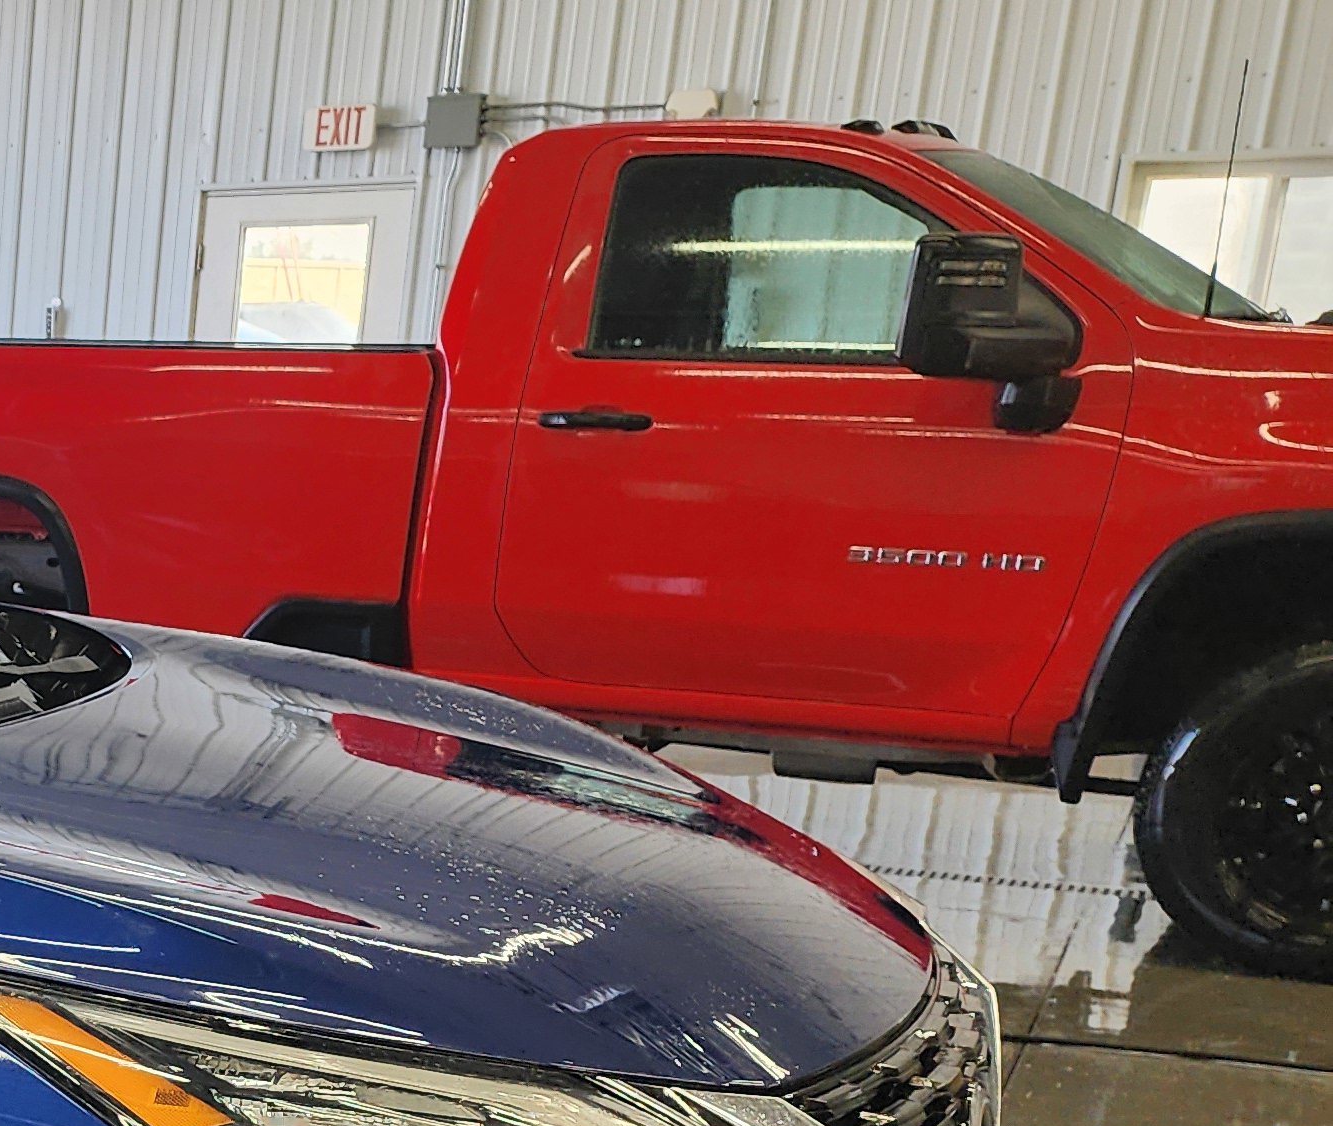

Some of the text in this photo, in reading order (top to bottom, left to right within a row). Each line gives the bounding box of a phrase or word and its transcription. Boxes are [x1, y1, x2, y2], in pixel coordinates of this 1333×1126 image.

[315, 106, 367, 147] EXIT
[847, 545, 1046, 572] 3500 HD
